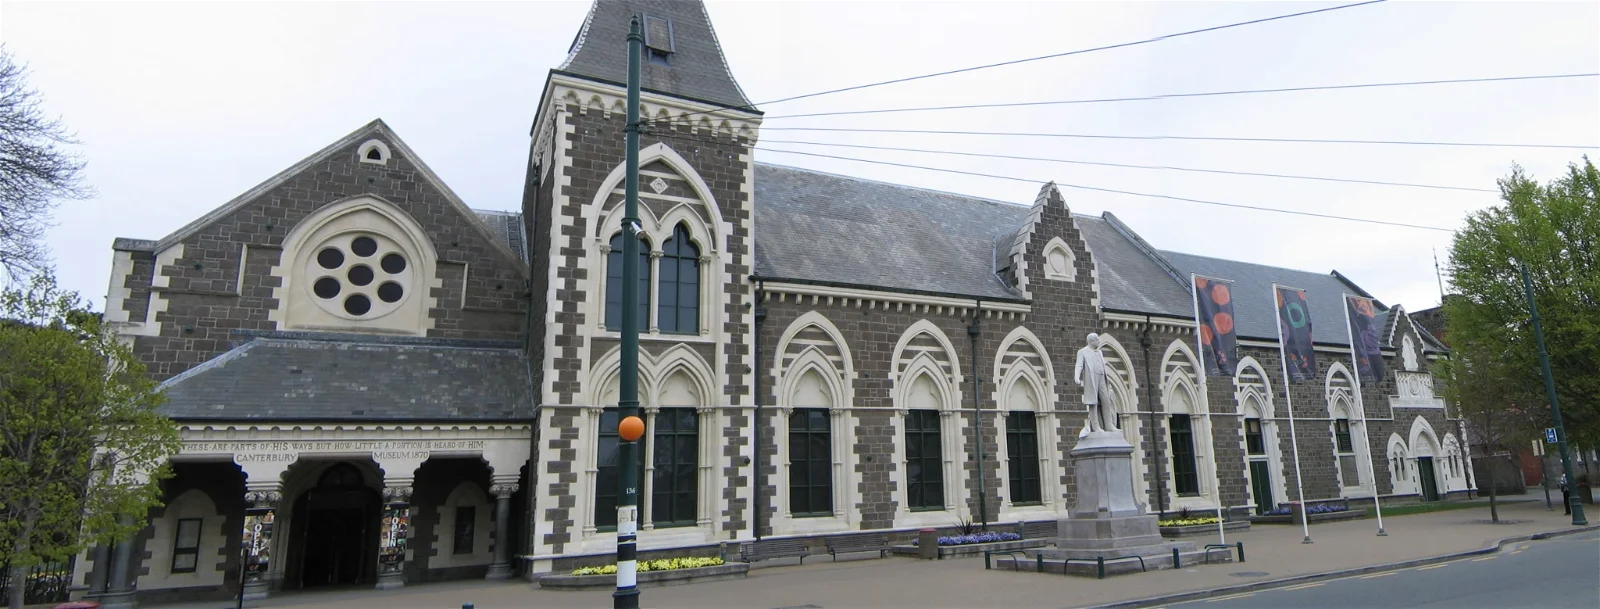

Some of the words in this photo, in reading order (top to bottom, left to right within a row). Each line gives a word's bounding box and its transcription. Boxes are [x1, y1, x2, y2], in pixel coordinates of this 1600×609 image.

[212, 443, 228, 451] ARE
[230, 443, 257, 451] PARTS
[272, 442, 289, 451] HIS
[292, 442, 313, 450] WAYS
[316, 442, 332, 450] BUT
[334, 442, 353, 450] HOW
[355, 442, 382, 450] LITTLE
[384, 442, 391, 450] A
[392, 442, 423, 450] PORTION
[425, 441, 432, 449] IS
[434, 441, 456, 449] HEARD
[457, 441, 467, 449] OF
[468, 440, 484, 449] HIM
[236, 453, 297, 462] CANTERBURY
[373, 451, 410, 460] MUSEUM
[411, 451, 429, 459] 1870
[390, 516, 399, 548] OPEN
[252, 523, 262, 556] OPEN
